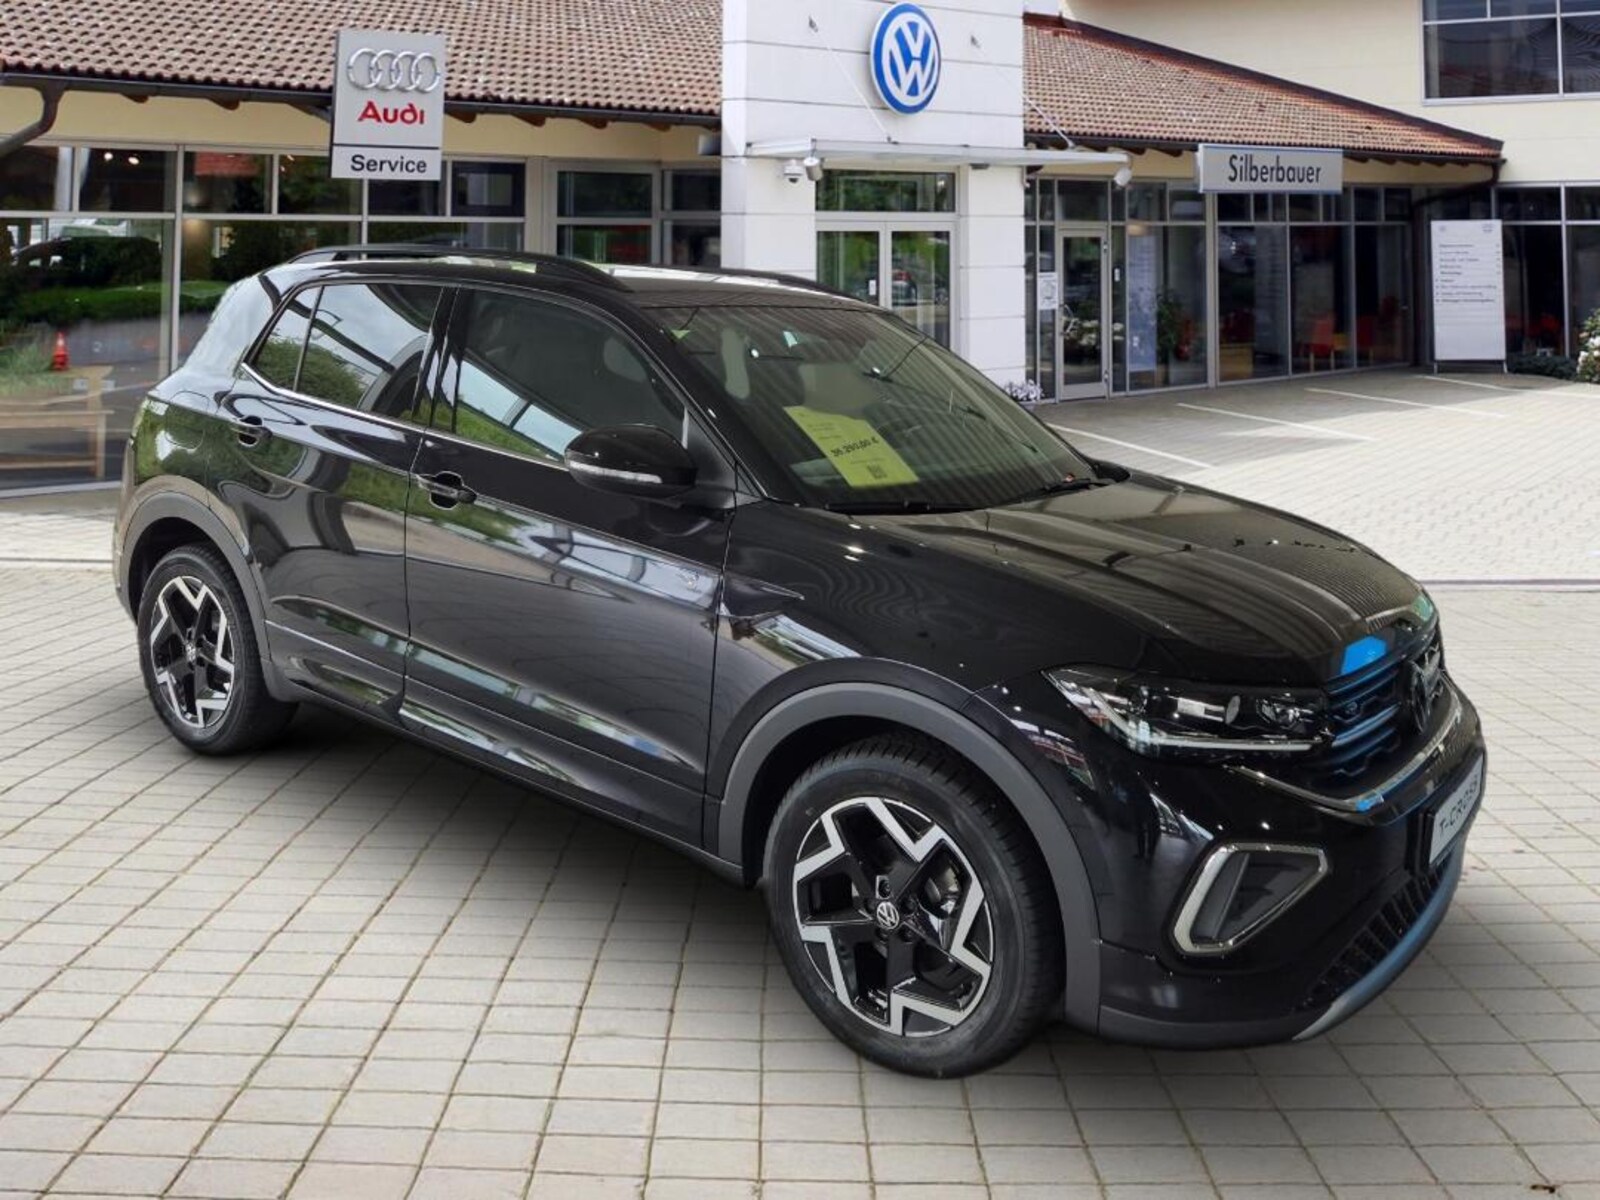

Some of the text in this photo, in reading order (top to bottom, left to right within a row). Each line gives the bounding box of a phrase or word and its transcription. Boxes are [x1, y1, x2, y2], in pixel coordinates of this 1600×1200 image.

[358, 101, 425, 125] Audi
[351, 154, 427, 173] Service
[1228, 154, 1322, 184] Silberbauer
